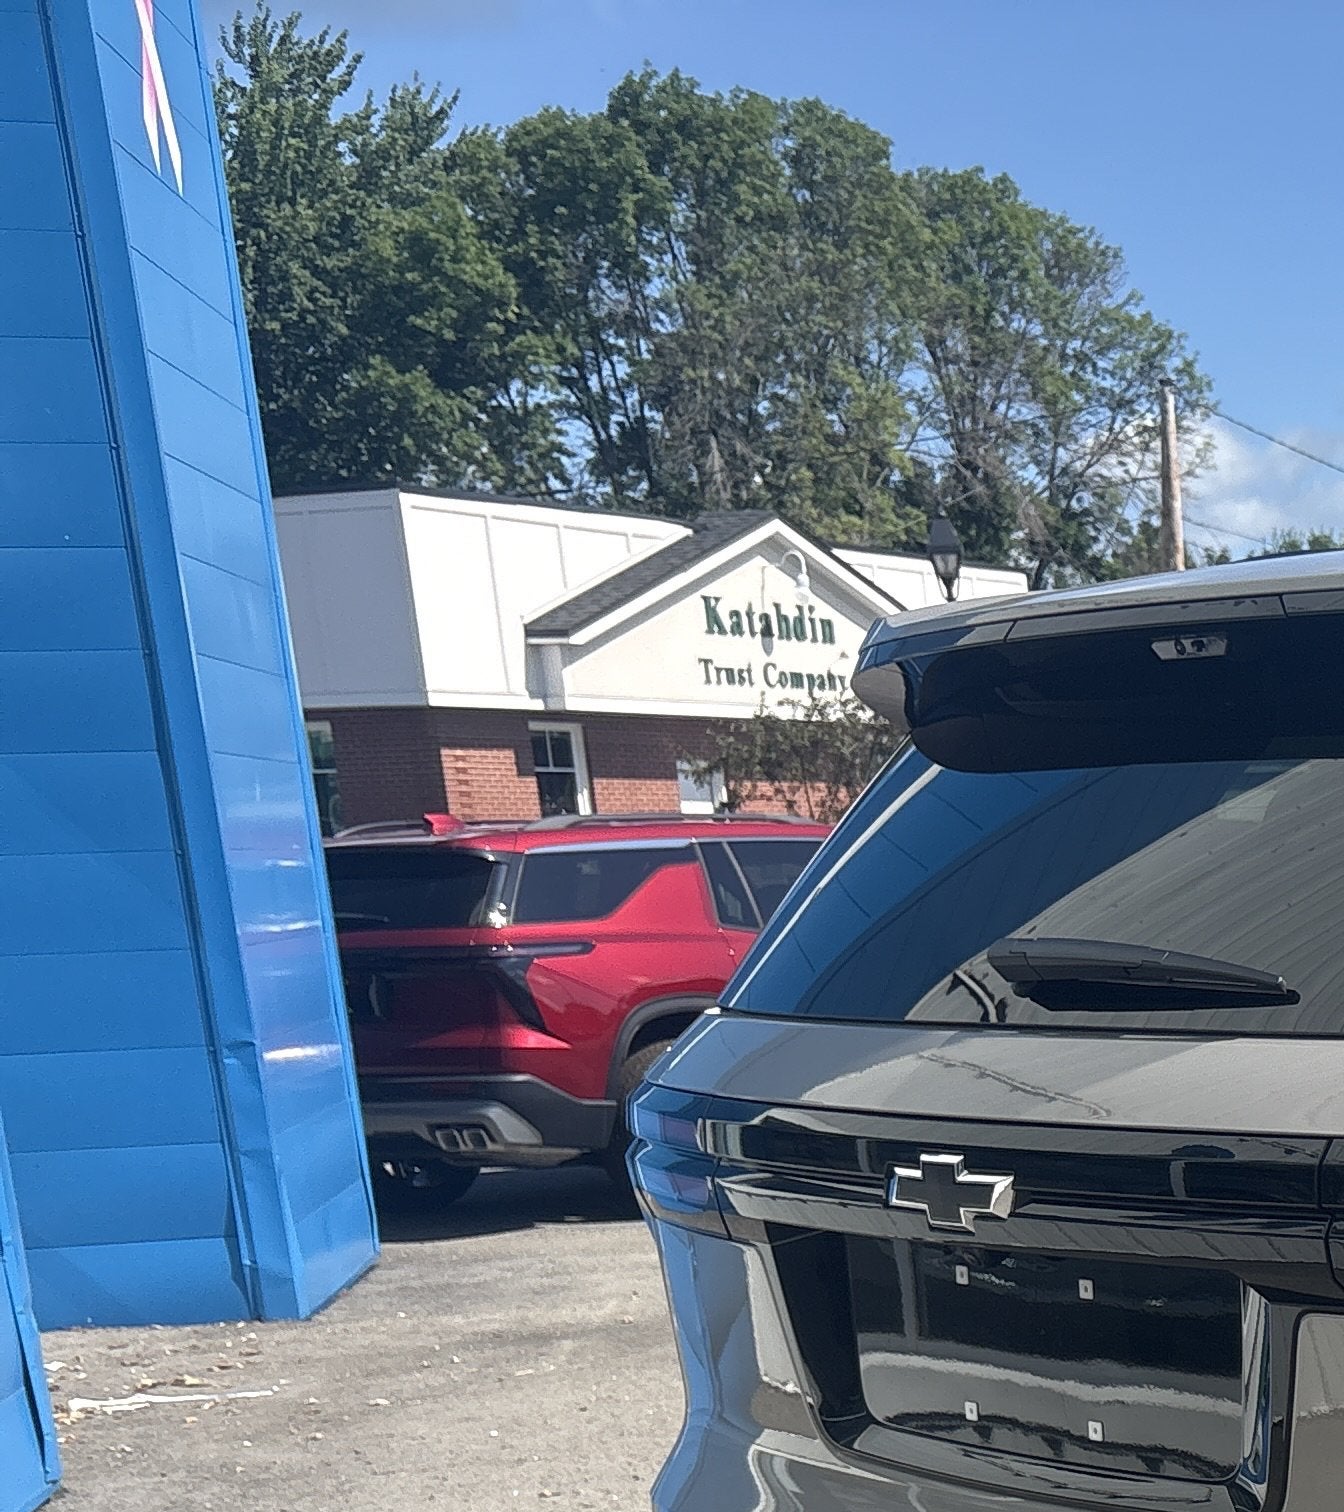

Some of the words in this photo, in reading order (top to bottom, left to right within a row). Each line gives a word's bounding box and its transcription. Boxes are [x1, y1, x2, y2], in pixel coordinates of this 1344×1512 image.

[701, 595, 835, 645] Katahdin
[698, 657, 754, 687] Trust
[763, 662, 849, 698] Company
